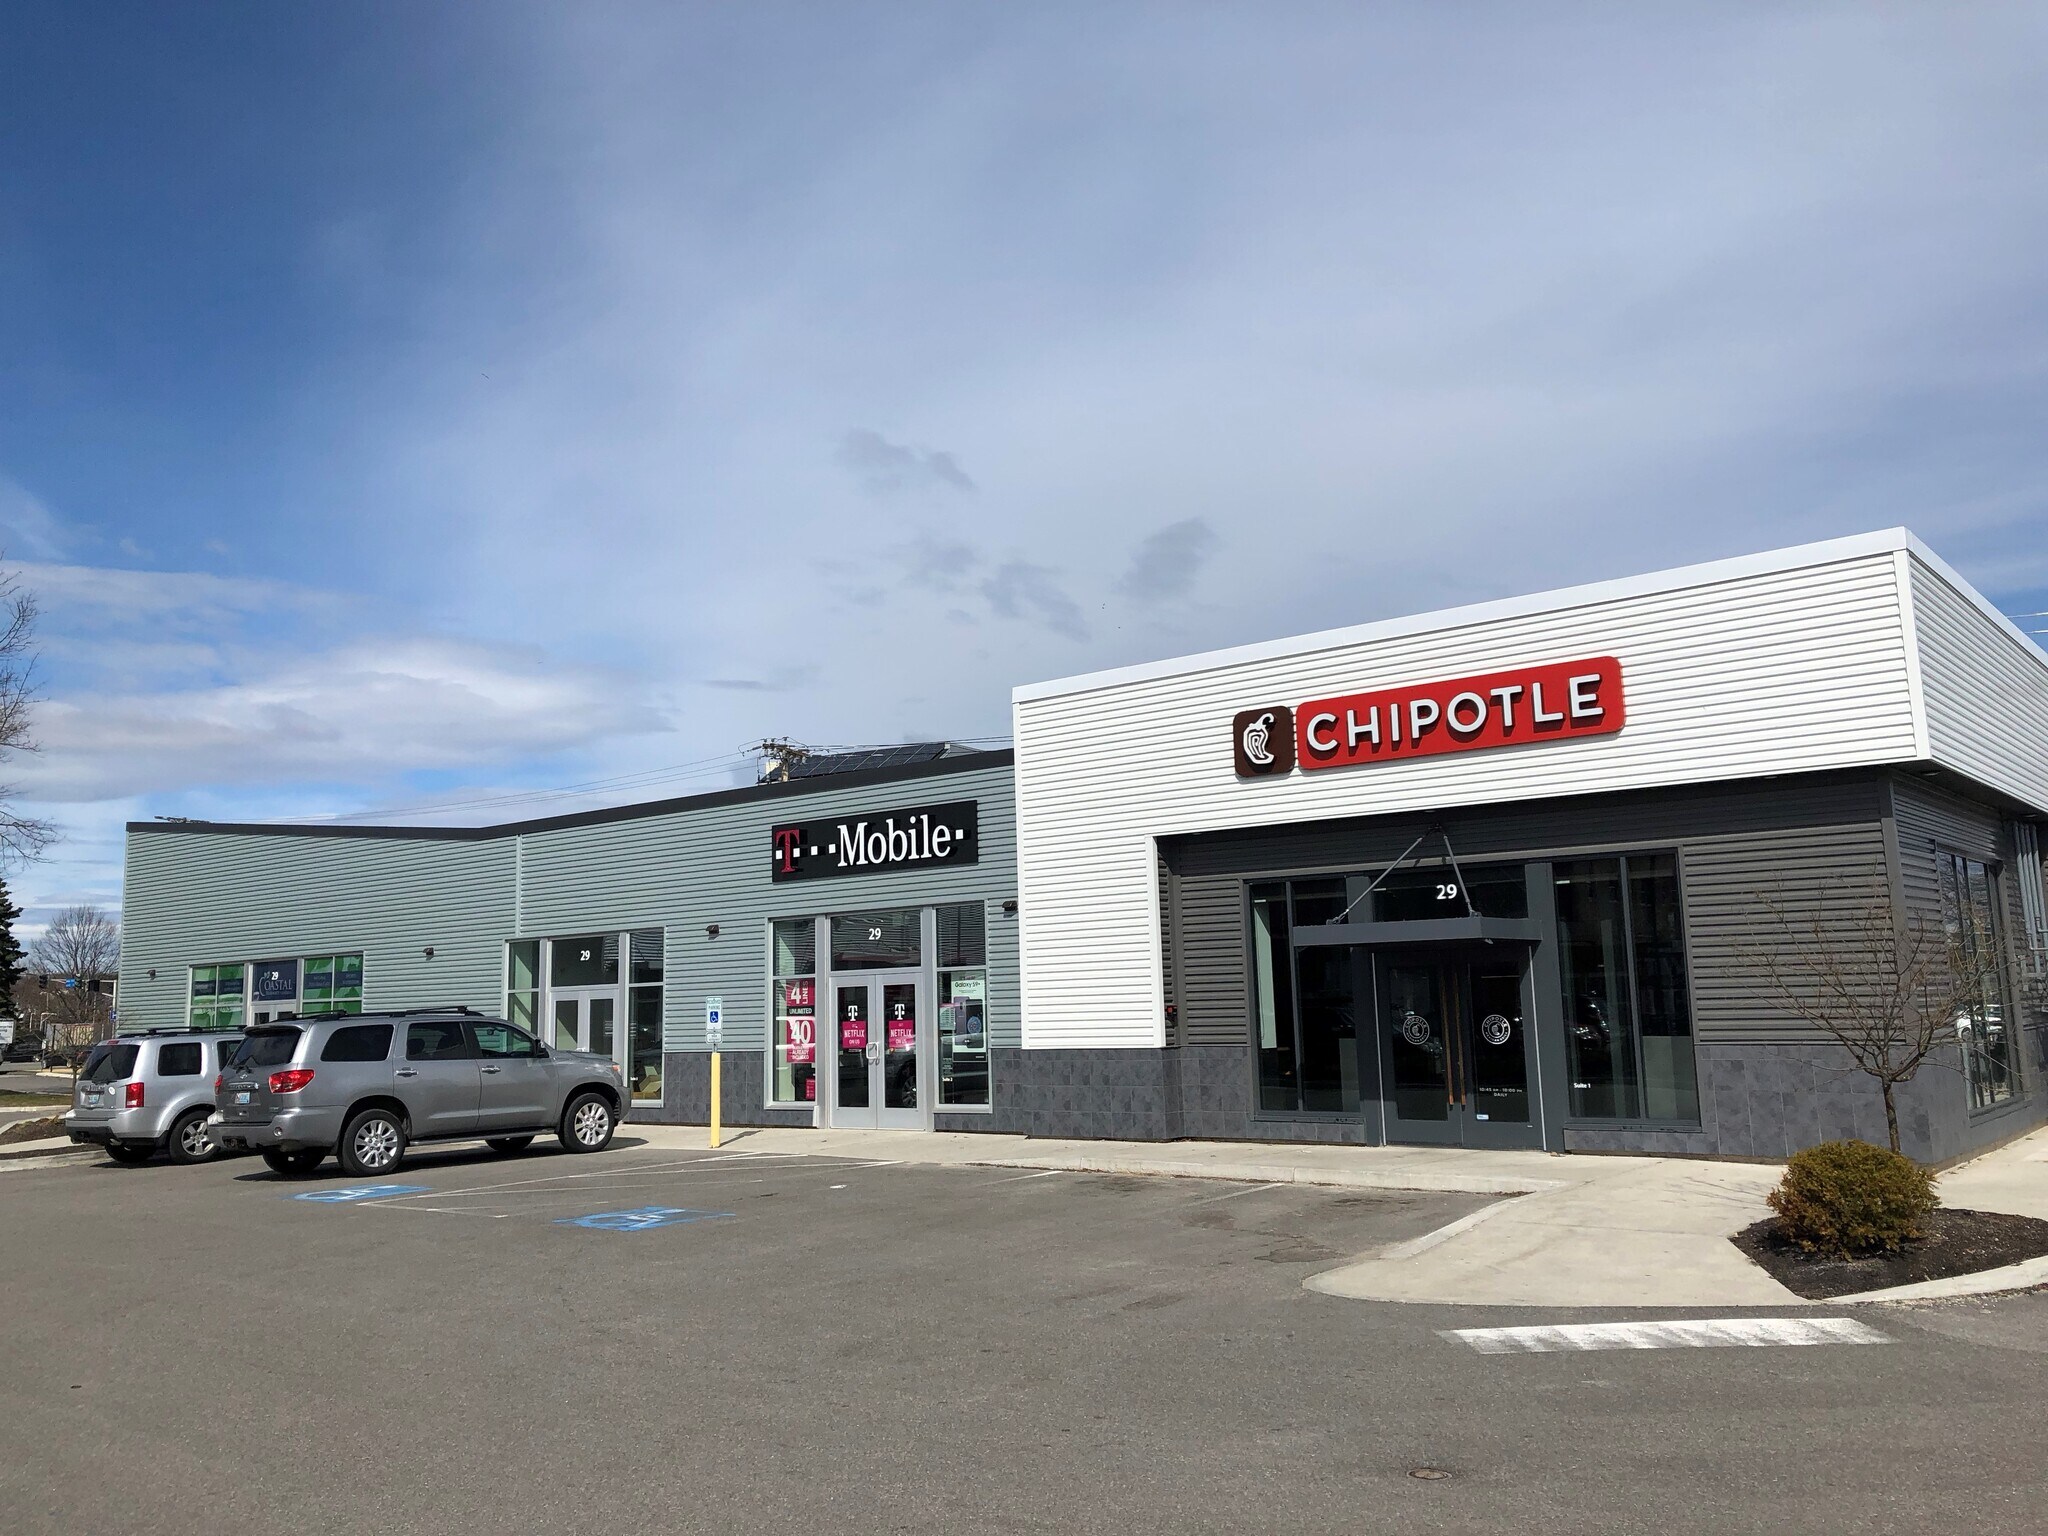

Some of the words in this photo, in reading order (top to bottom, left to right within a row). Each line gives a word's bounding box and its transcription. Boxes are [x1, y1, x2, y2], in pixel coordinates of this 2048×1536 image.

[1306, 673, 1604, 752] CHIPOTLE
[1436, 884, 1457, 900] 29
[868, 927, 882, 940] 29
[580, 950, 591, 961] 29
[271, 971, 279, 980] 29
[259, 977, 293, 996] COASTAL
[791, 981, 801, 1004] 4
[848, 1005, 858, 1021] T
[895, 1004, 905, 1020] T
[790, 1020, 812, 1044] 40
[844, 1029, 865, 1038] NETFLIX
[890, 1028, 912, 1038] NETFLIX
